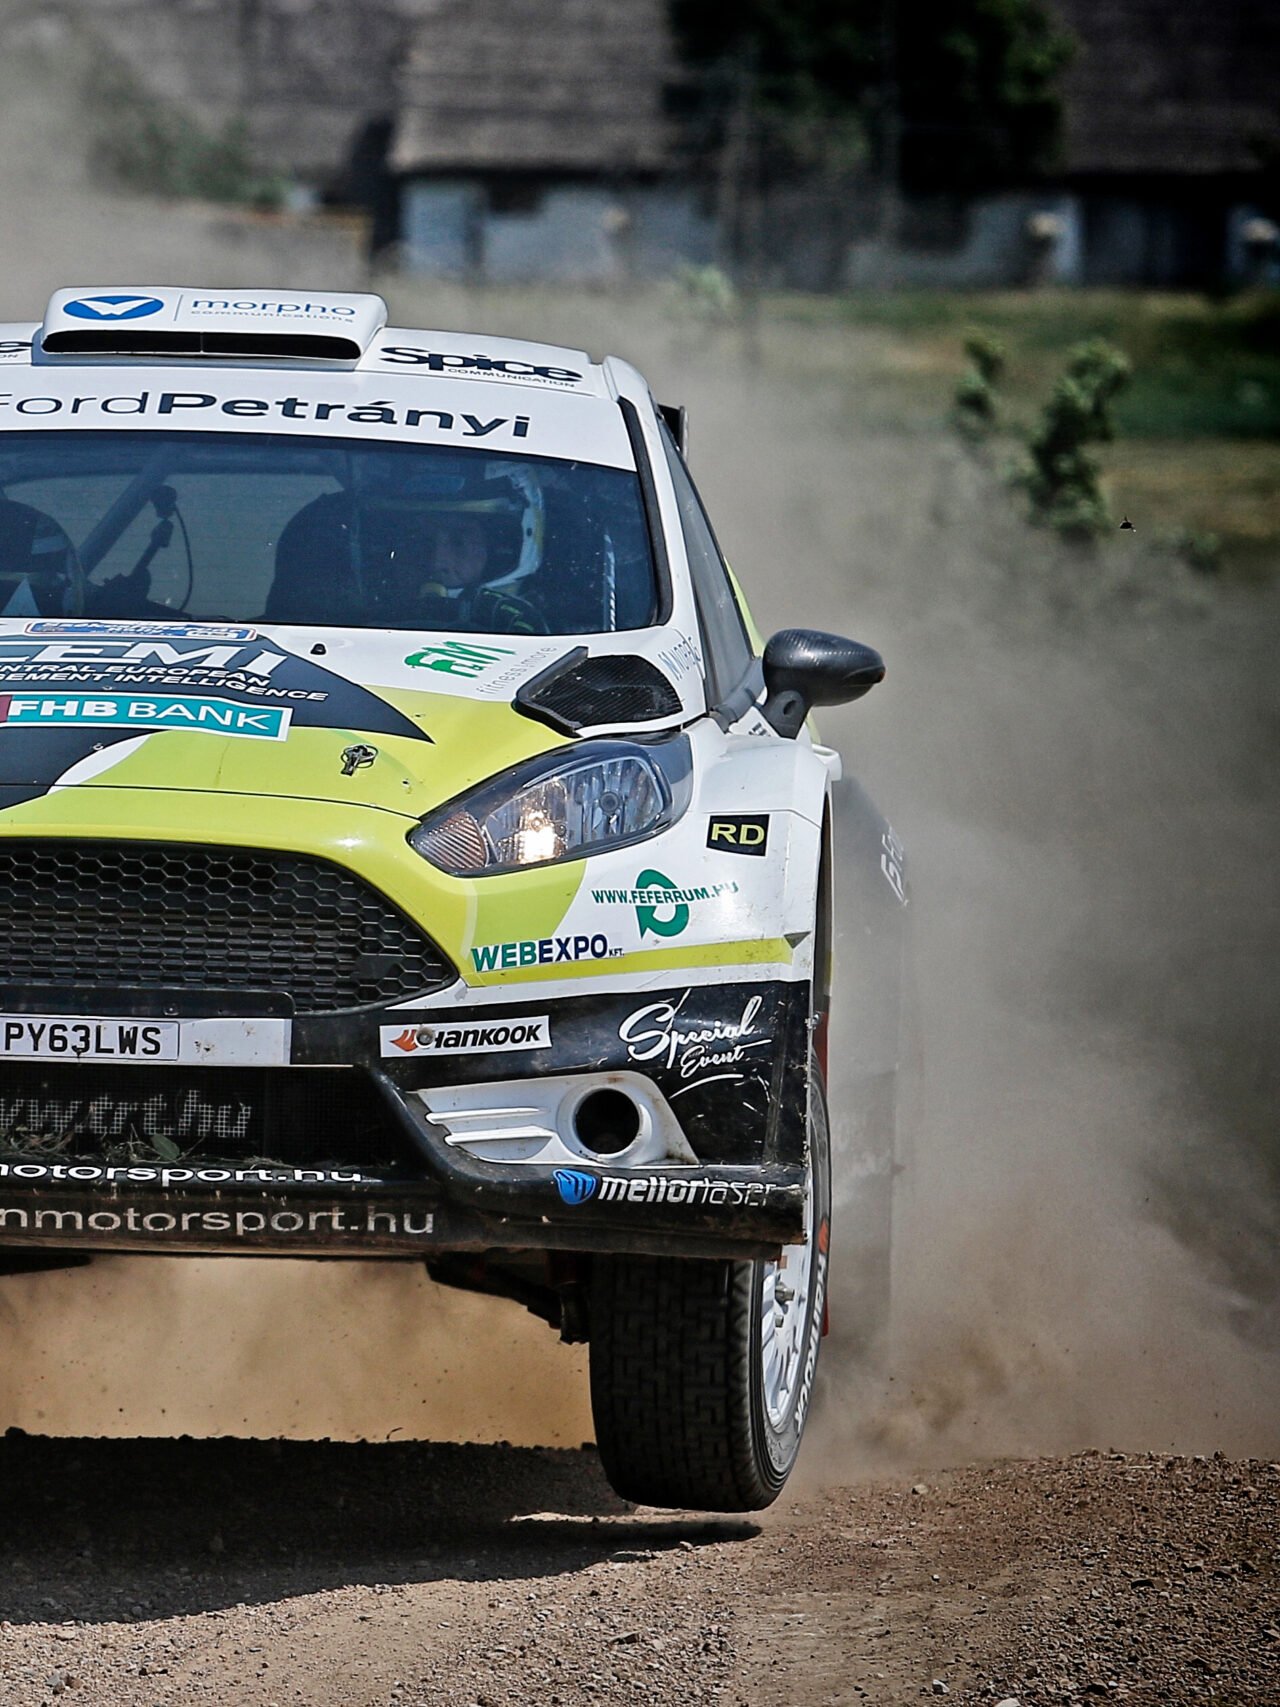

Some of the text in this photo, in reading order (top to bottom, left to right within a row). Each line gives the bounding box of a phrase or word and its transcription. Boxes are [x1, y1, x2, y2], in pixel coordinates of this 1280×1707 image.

[192, 300, 356, 316] morpho
[447, 368, 577, 388] COMMUNICATION
[103, 664, 271, 688] EUROPEAN
[113, 673, 330, 702] INTELLIGENCE
[7, 700, 272, 731] FHB BANK
[710, 823, 766, 846] RD
[471, 933, 609, 973] WEBEXPO
[619, 994, 763, 1070] Special
[680, 1039, 772, 1079] Event
